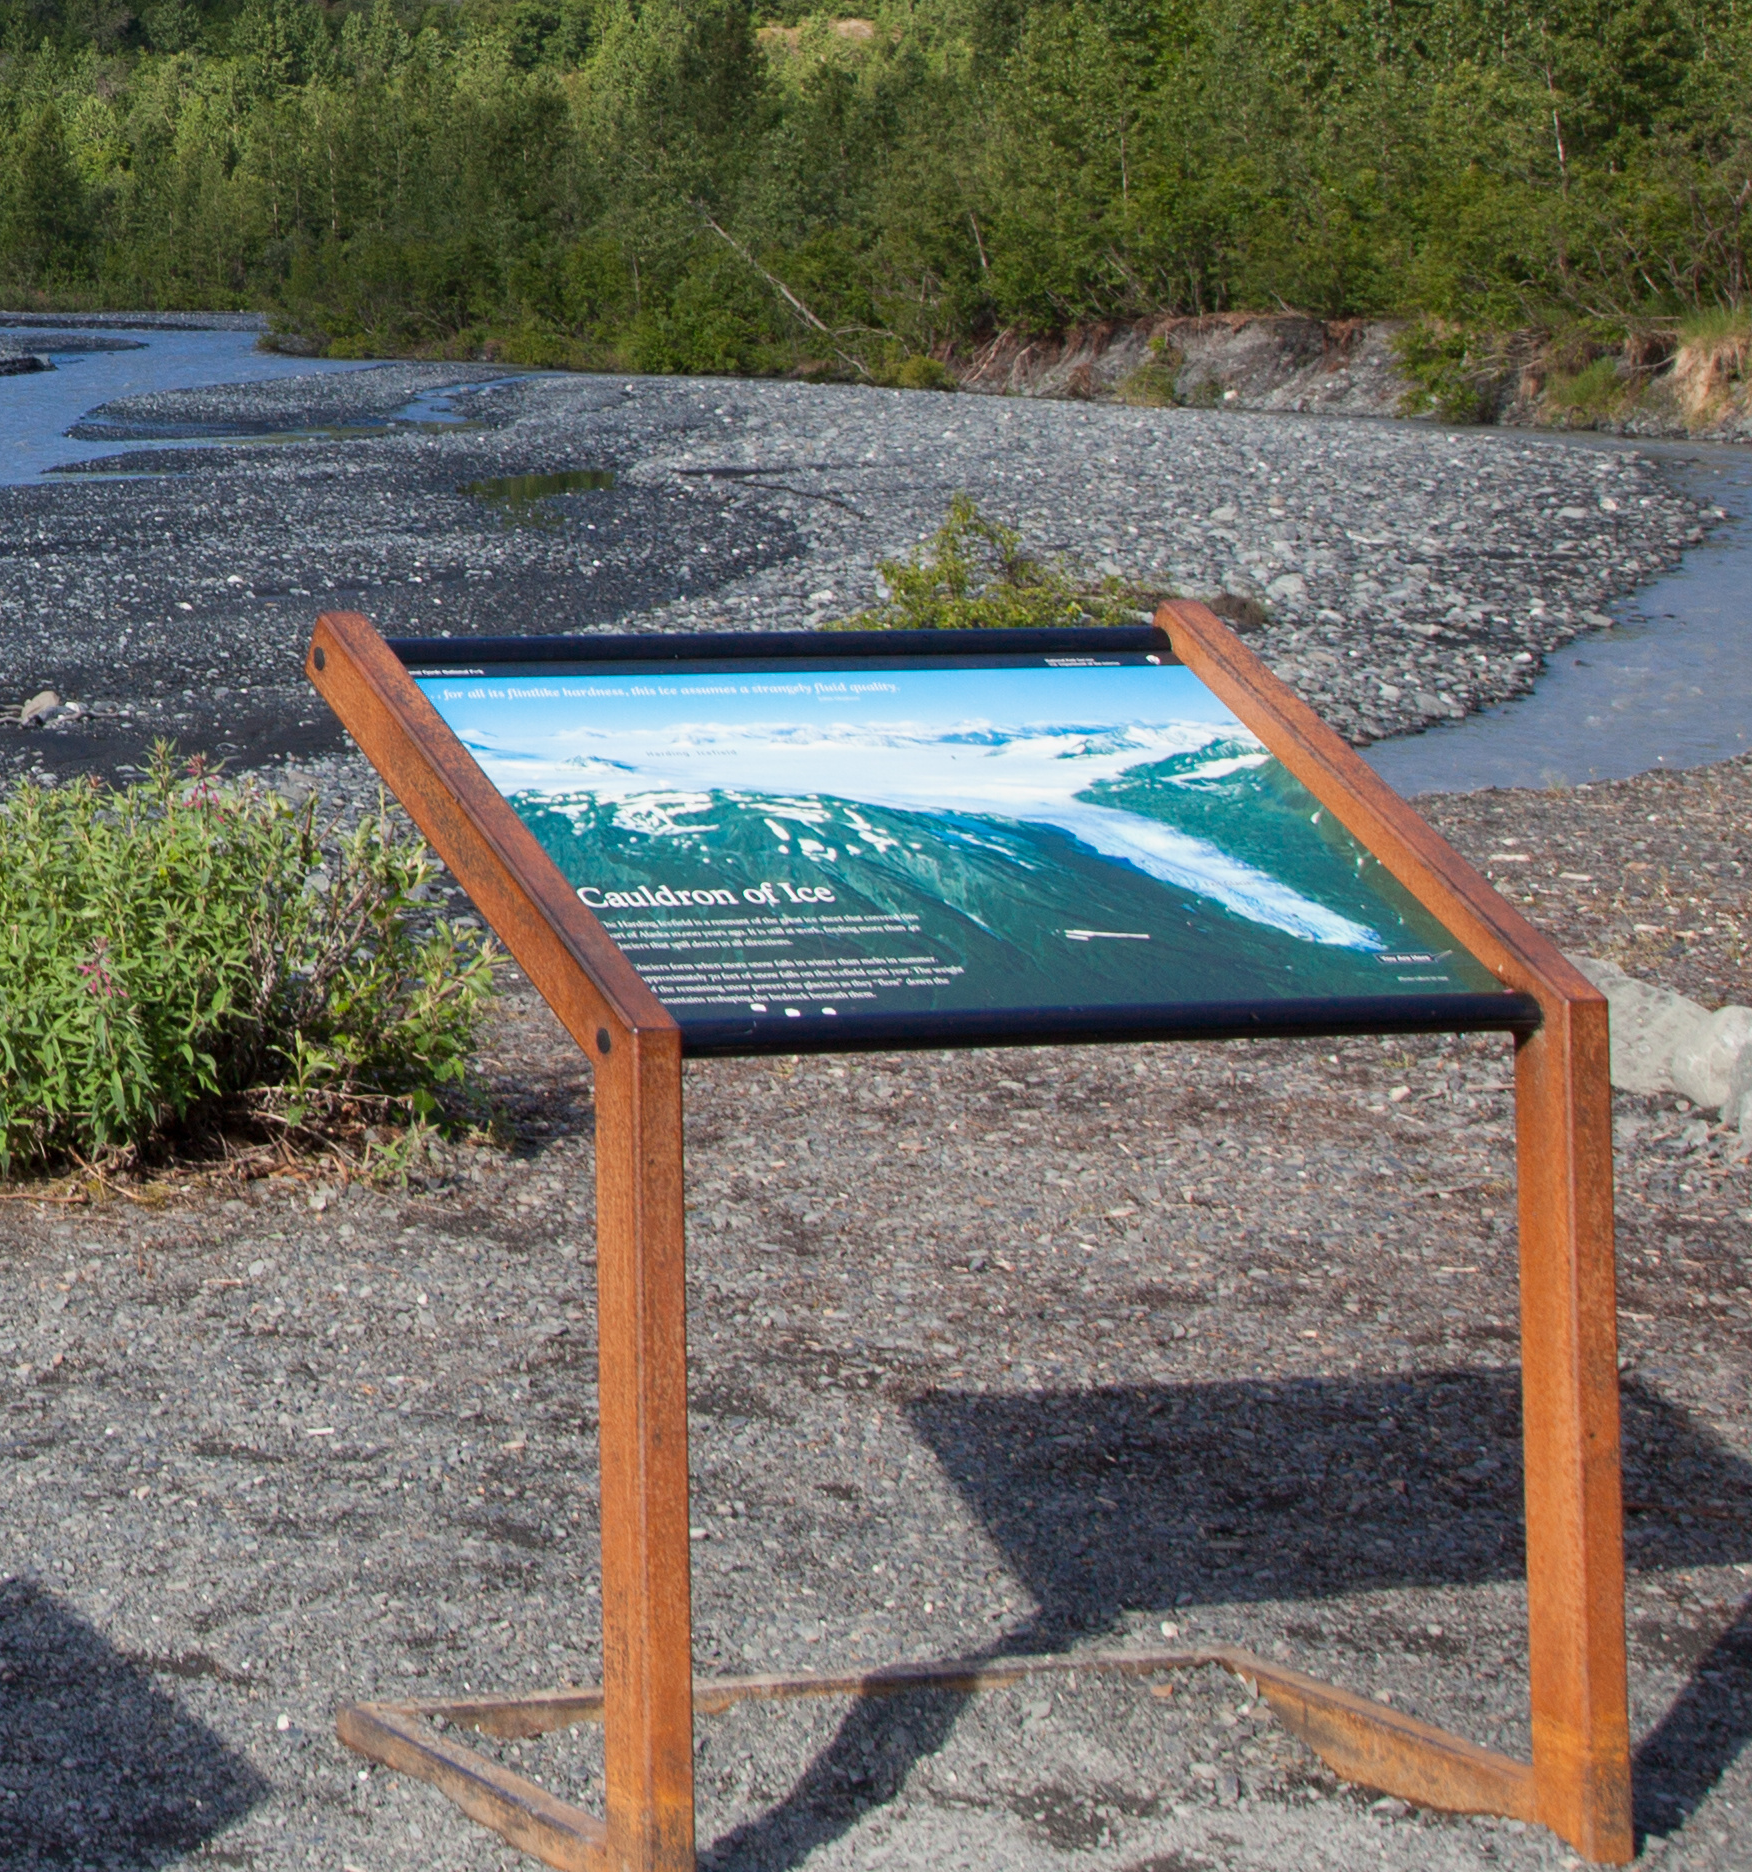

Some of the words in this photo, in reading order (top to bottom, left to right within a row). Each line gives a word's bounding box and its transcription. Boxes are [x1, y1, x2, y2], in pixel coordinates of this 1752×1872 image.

[442, 690, 464, 701] for
[467, 689, 485, 698] all
[488, 689, 505, 698] its
[506, 688, 559, 700] flintlike
[562, 687, 629, 698] hardness,
[630, 686, 656, 695] this
[751, 683, 812, 694] strangely
[813, 682, 846, 694] fluid
[848, 681, 899, 693] quality.
[577, 885, 739, 908] Cauldron
[743, 882, 780, 907] of
[777, 882, 836, 903] Ice
[1411, 954, 1432, 962] Here
